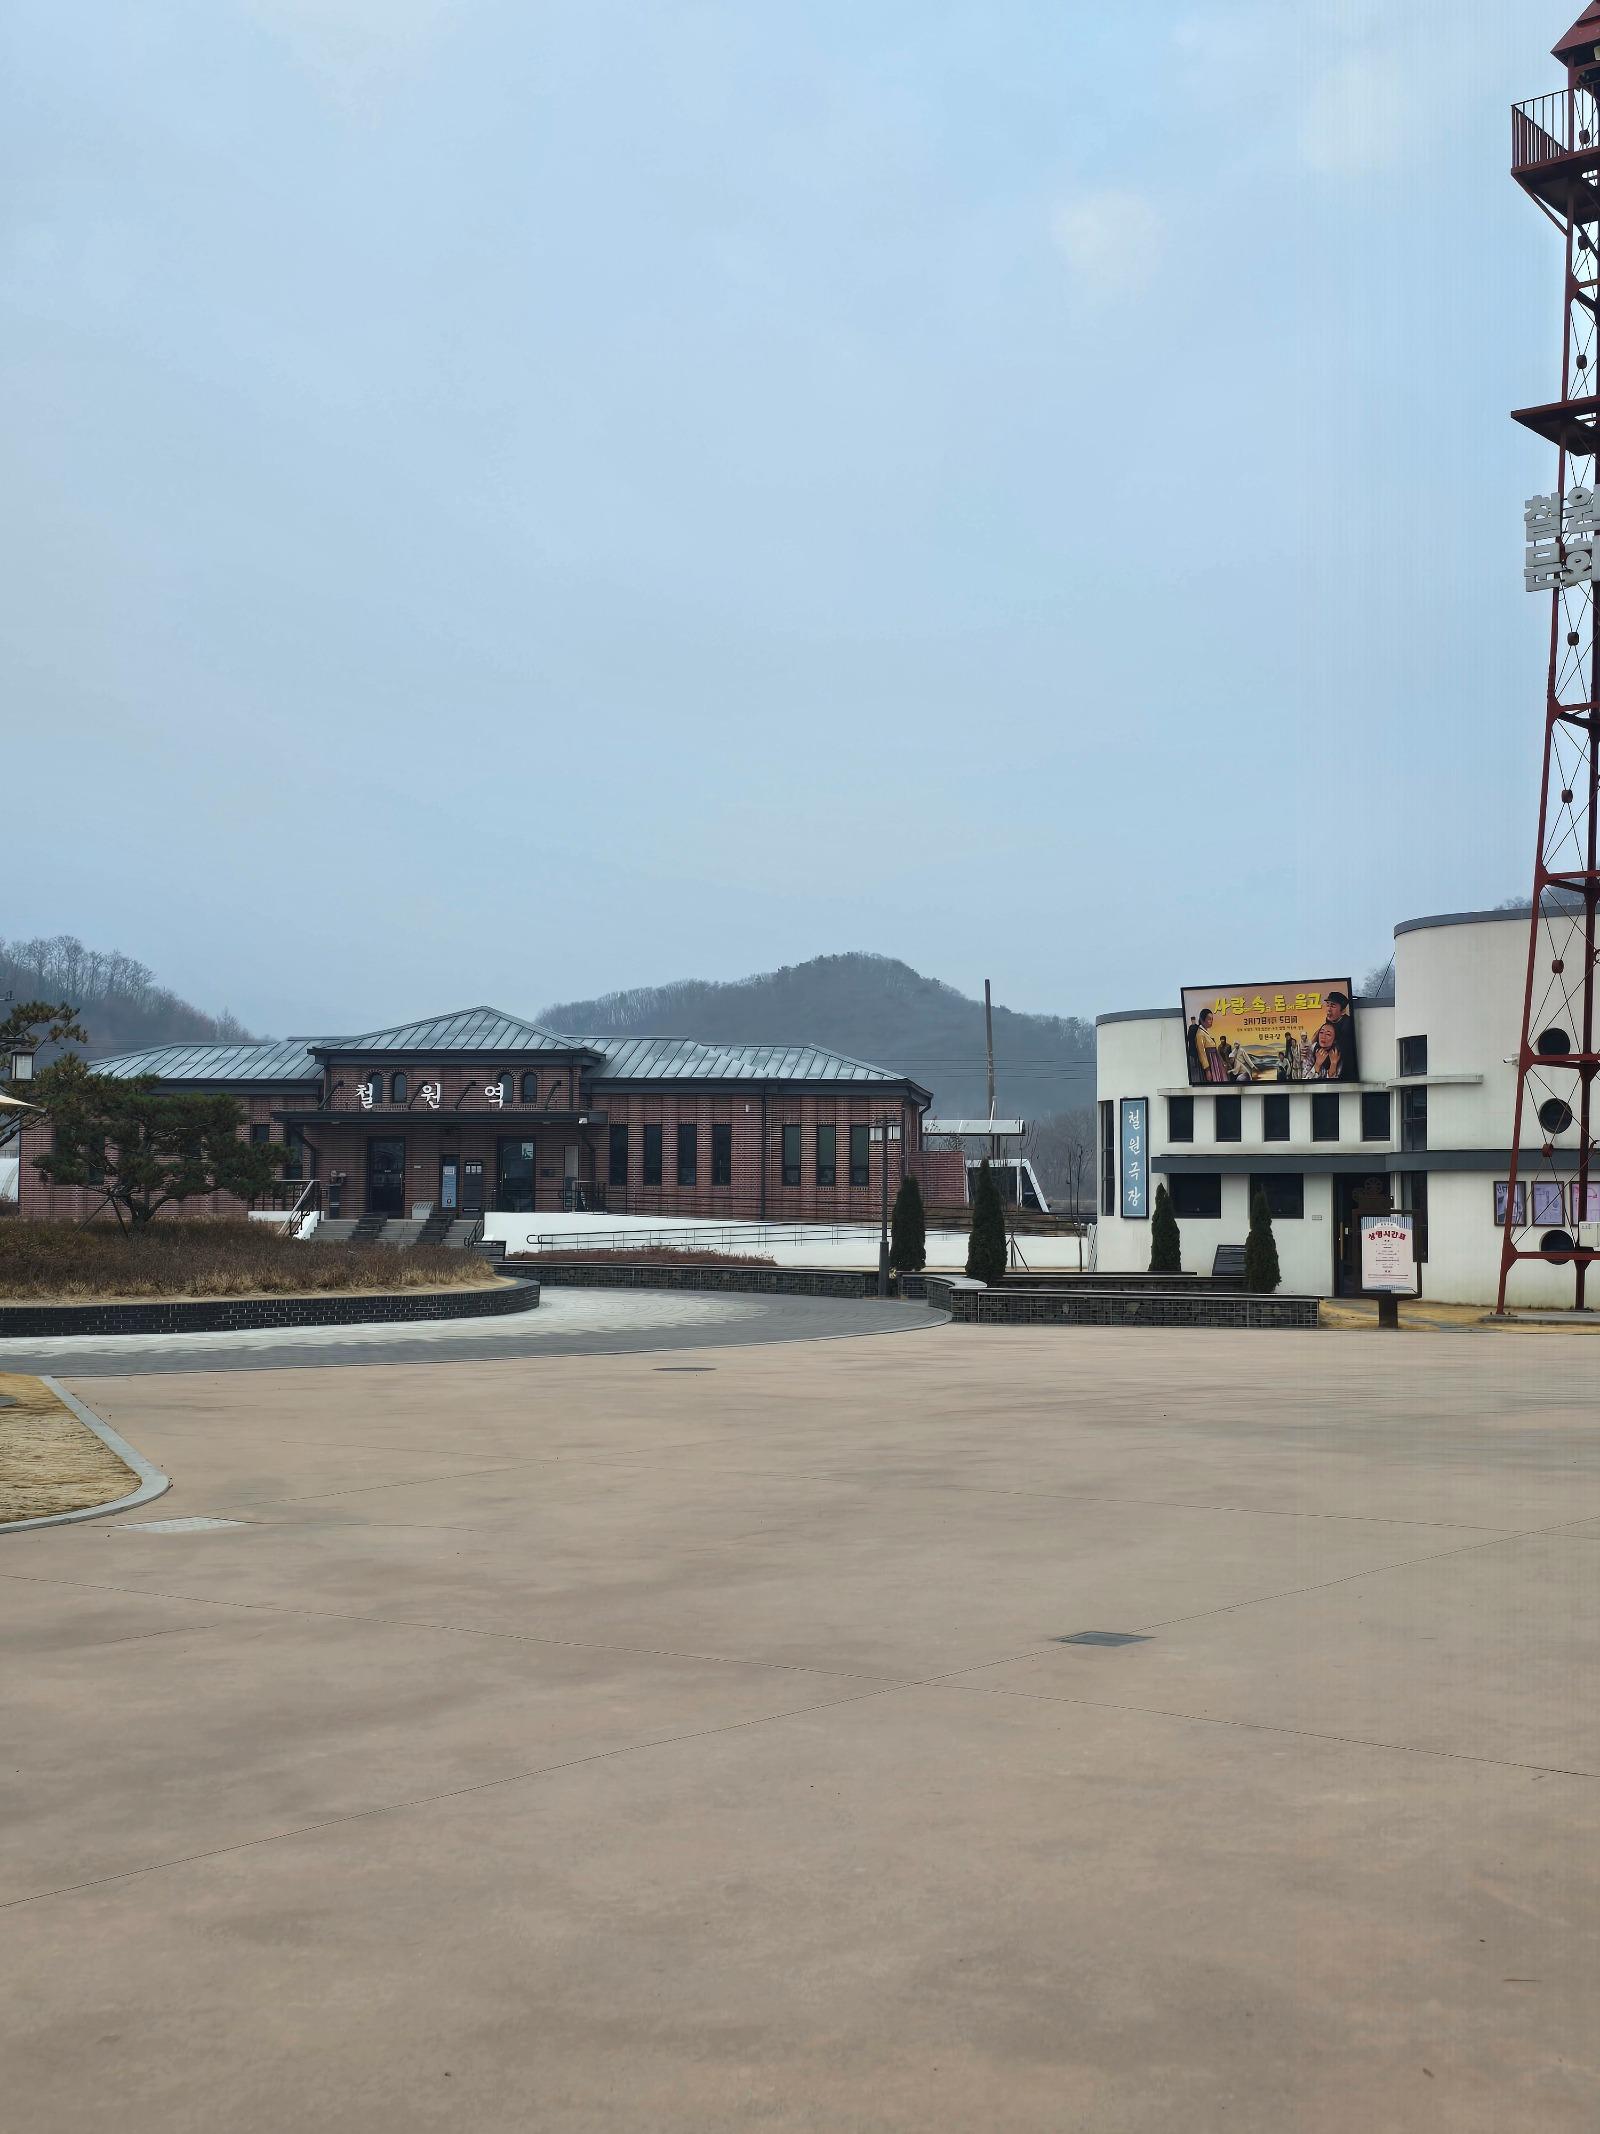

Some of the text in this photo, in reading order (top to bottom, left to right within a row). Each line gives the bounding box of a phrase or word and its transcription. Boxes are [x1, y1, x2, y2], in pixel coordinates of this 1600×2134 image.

[1214, 997, 1250, 1016] 사랑
[1296, 992, 1322, 1010] 울고
[355, 1082, 504, 1109] 철원역
[1128, 1109, 1141, 1207] 철원극장
